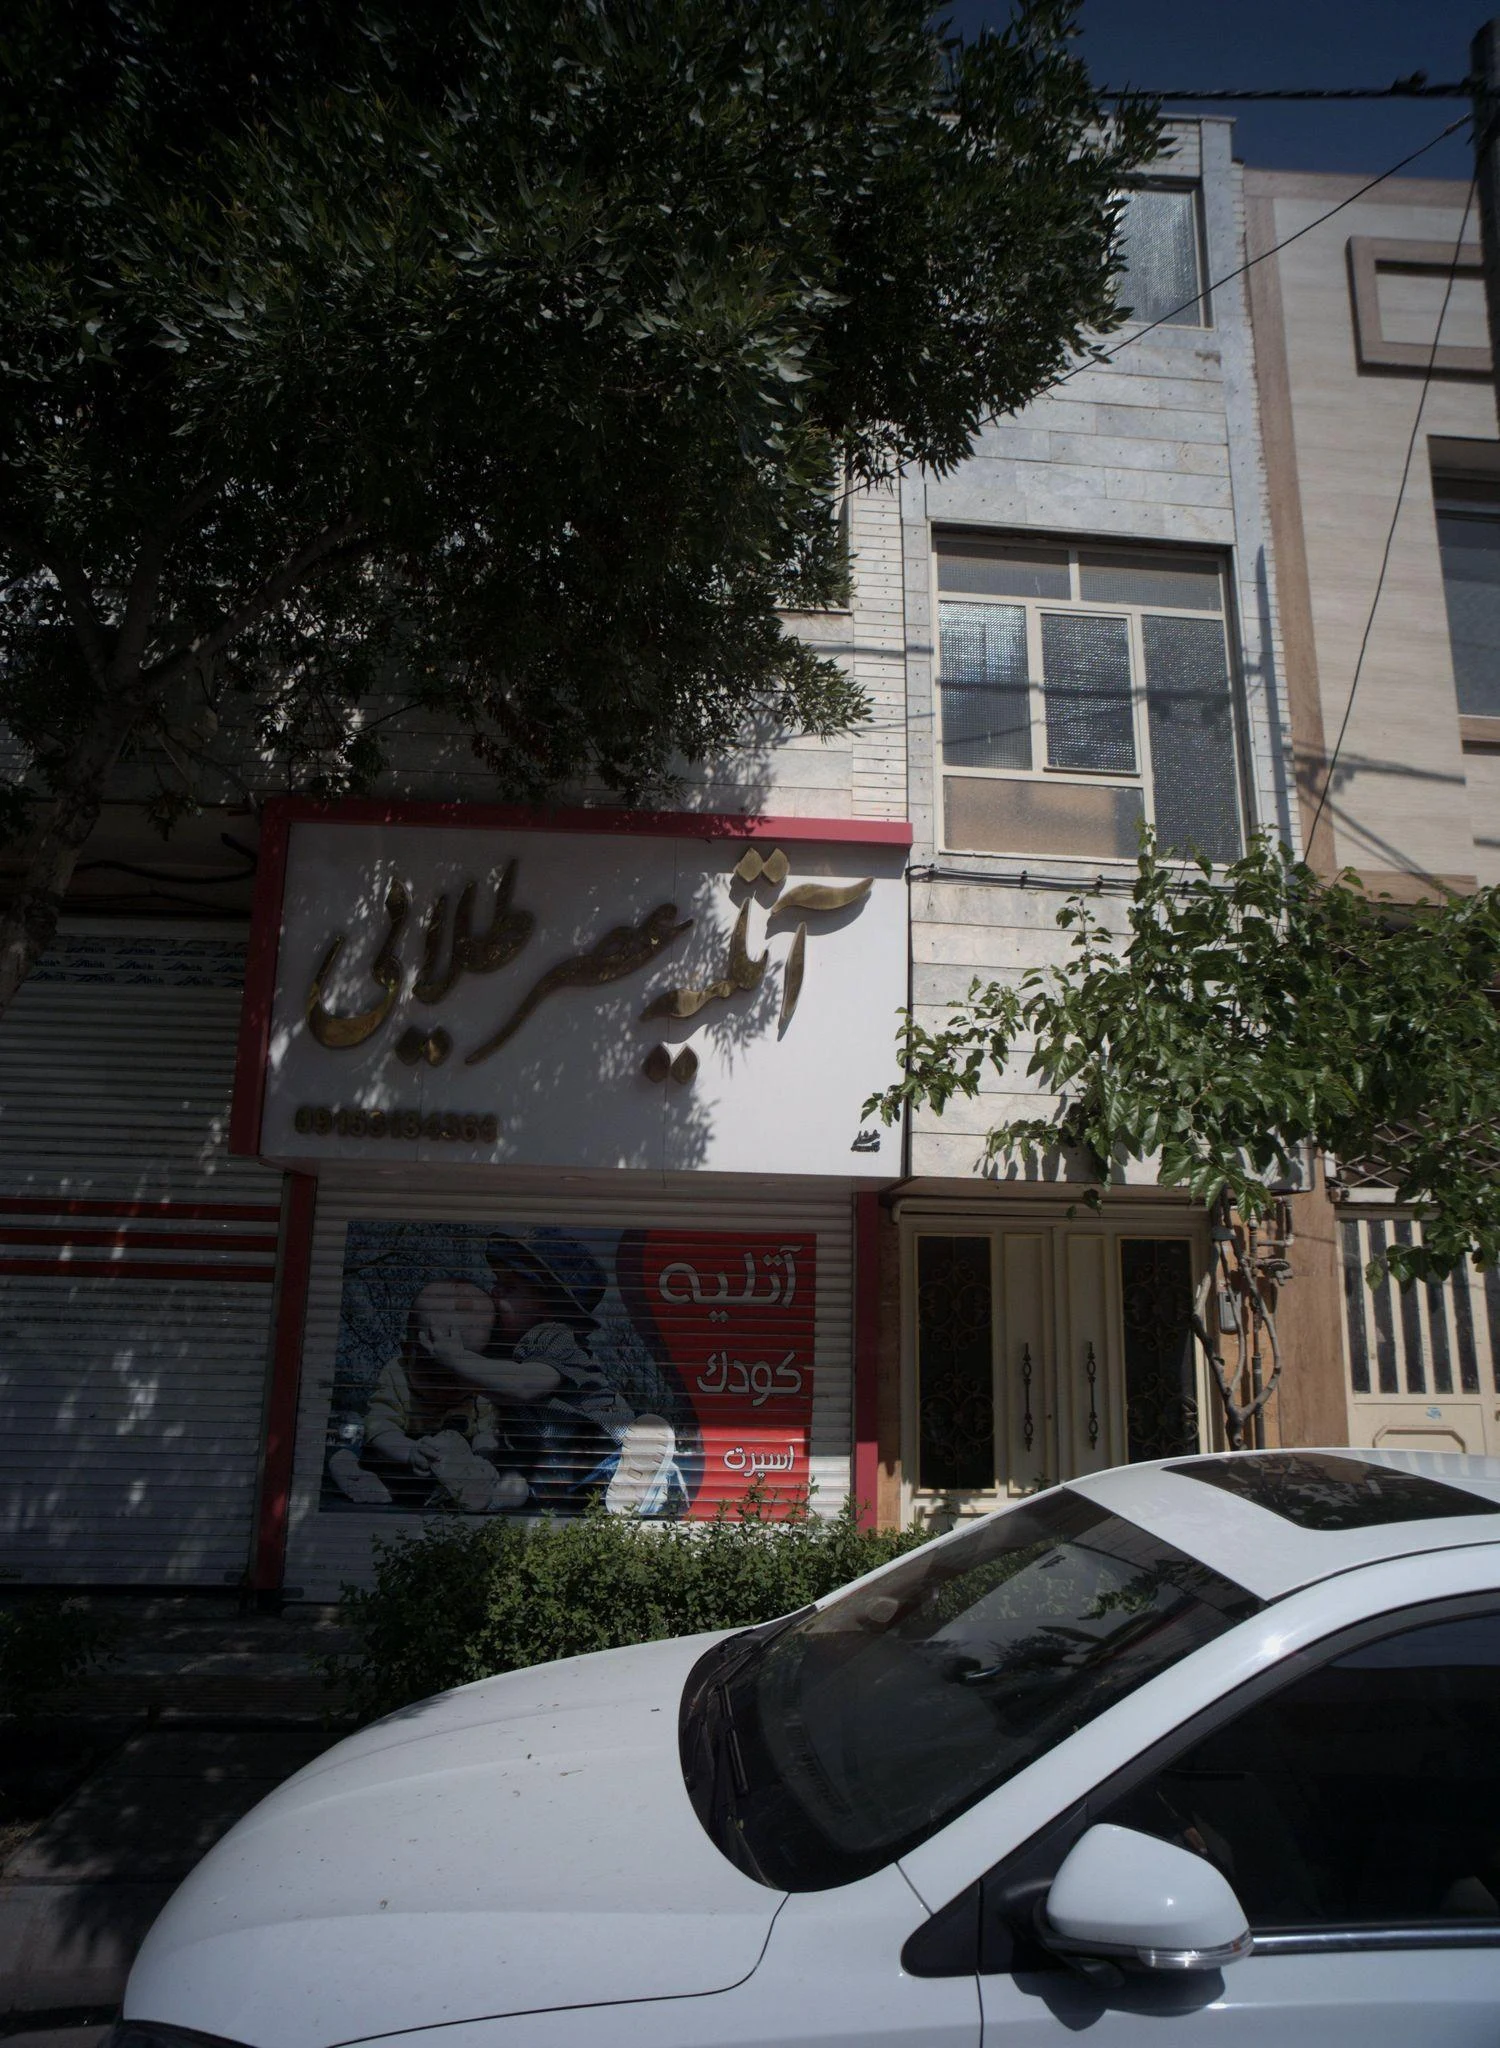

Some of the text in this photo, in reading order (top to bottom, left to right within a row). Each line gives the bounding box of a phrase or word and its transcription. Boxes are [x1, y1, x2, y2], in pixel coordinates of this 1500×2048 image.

[464, 902, 694, 1066] عصر
[641, 846, 874, 1086] آتلیه
[658, 1244, 803, 1324] آتلیه
